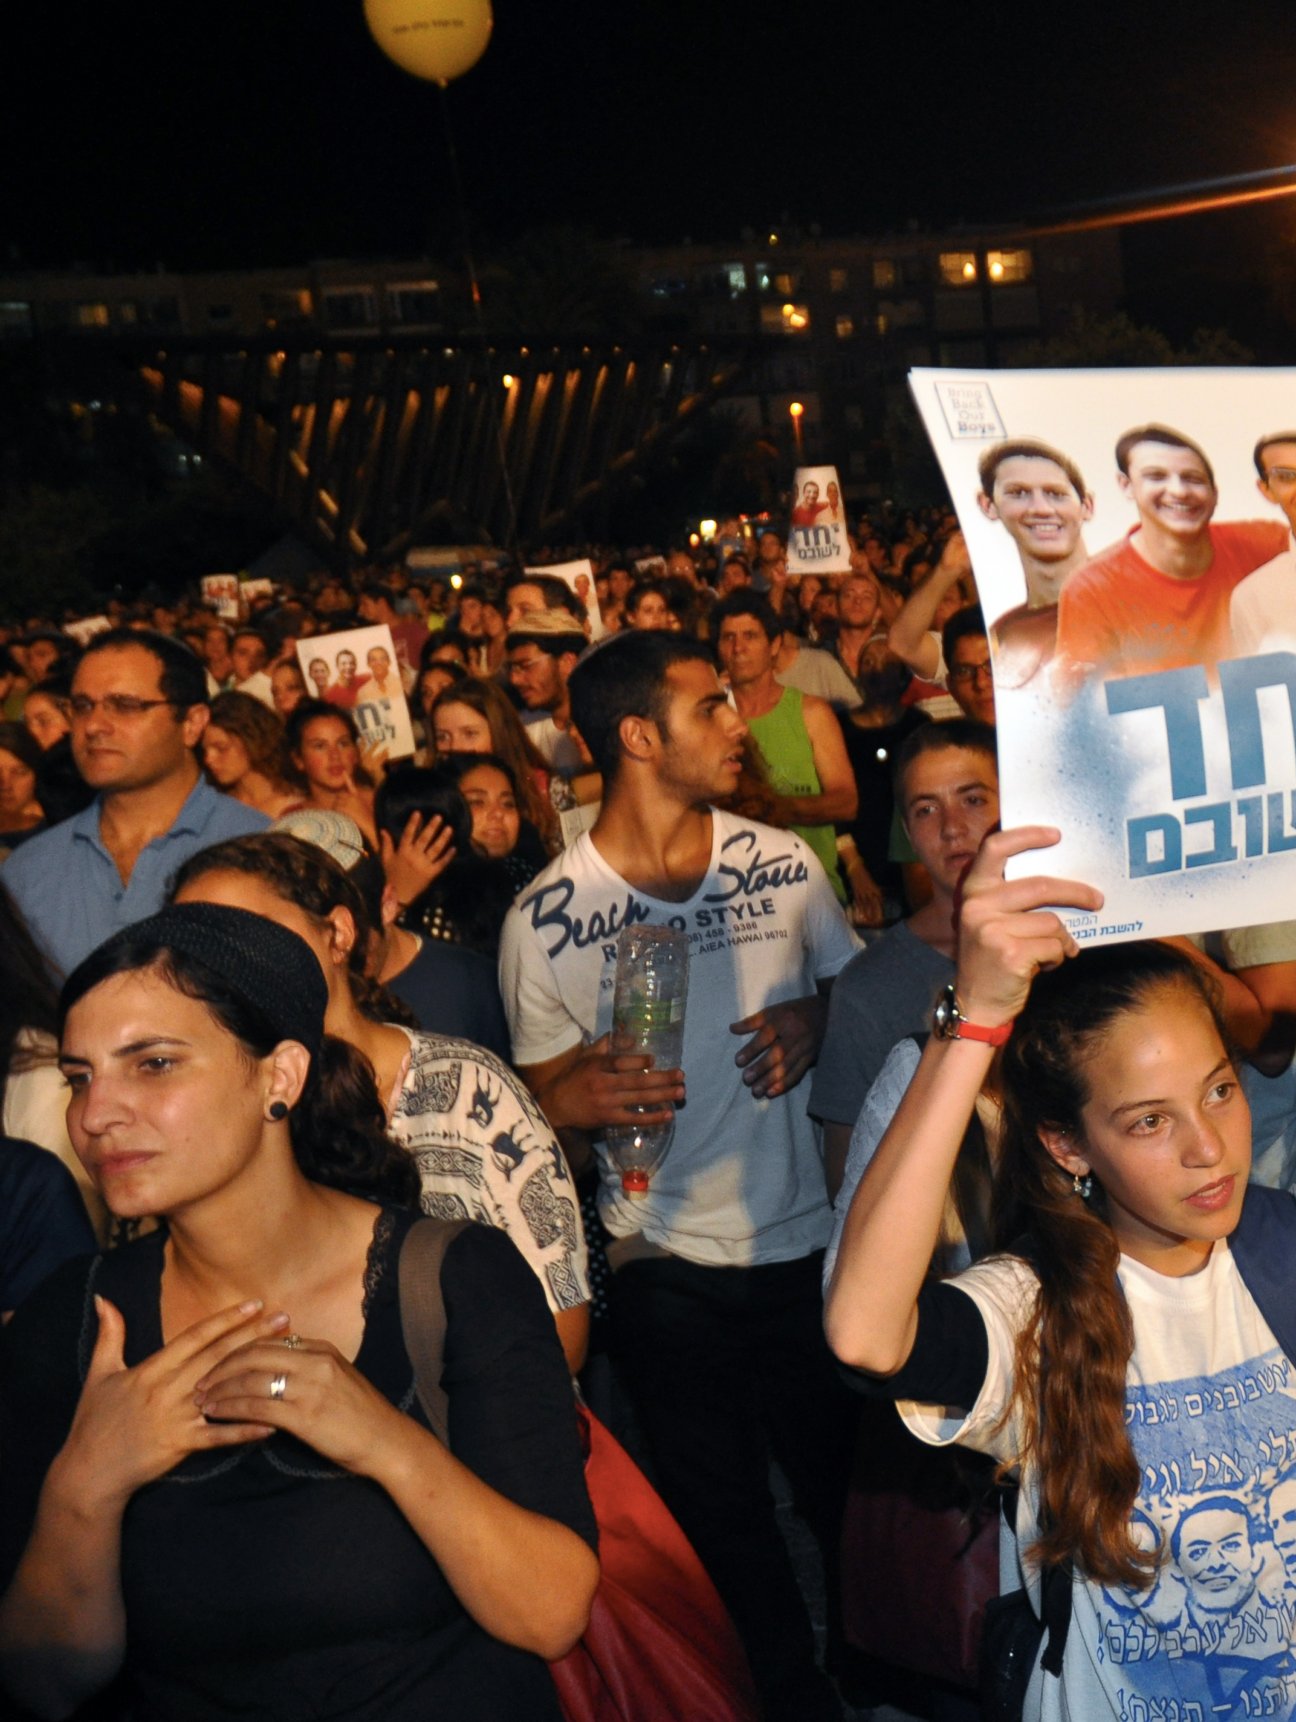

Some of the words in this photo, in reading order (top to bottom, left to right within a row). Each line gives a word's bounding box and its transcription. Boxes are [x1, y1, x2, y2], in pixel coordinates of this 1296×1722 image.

[957, 420, 997, 434] Boys
[794, 523, 840, 547] יחד
[356, 697, 391, 731] יח
[520, 876, 650, 960] Beach
[694, 898, 777, 928] STYLE
[1099, 920, 1144, 936] להשבת
[727, 931, 763, 948] HAWAI
[1072, 927, 1097, 940] הבני
[1124, 1392, 1181, 1427] לגבול
[1183, 1383, 1242, 1419] בנים
[1138, 1459, 1183, 1498] וגי
[1189, 1448, 1245, 1491] איל
[1165, 1620, 1222, 1660] ערב
